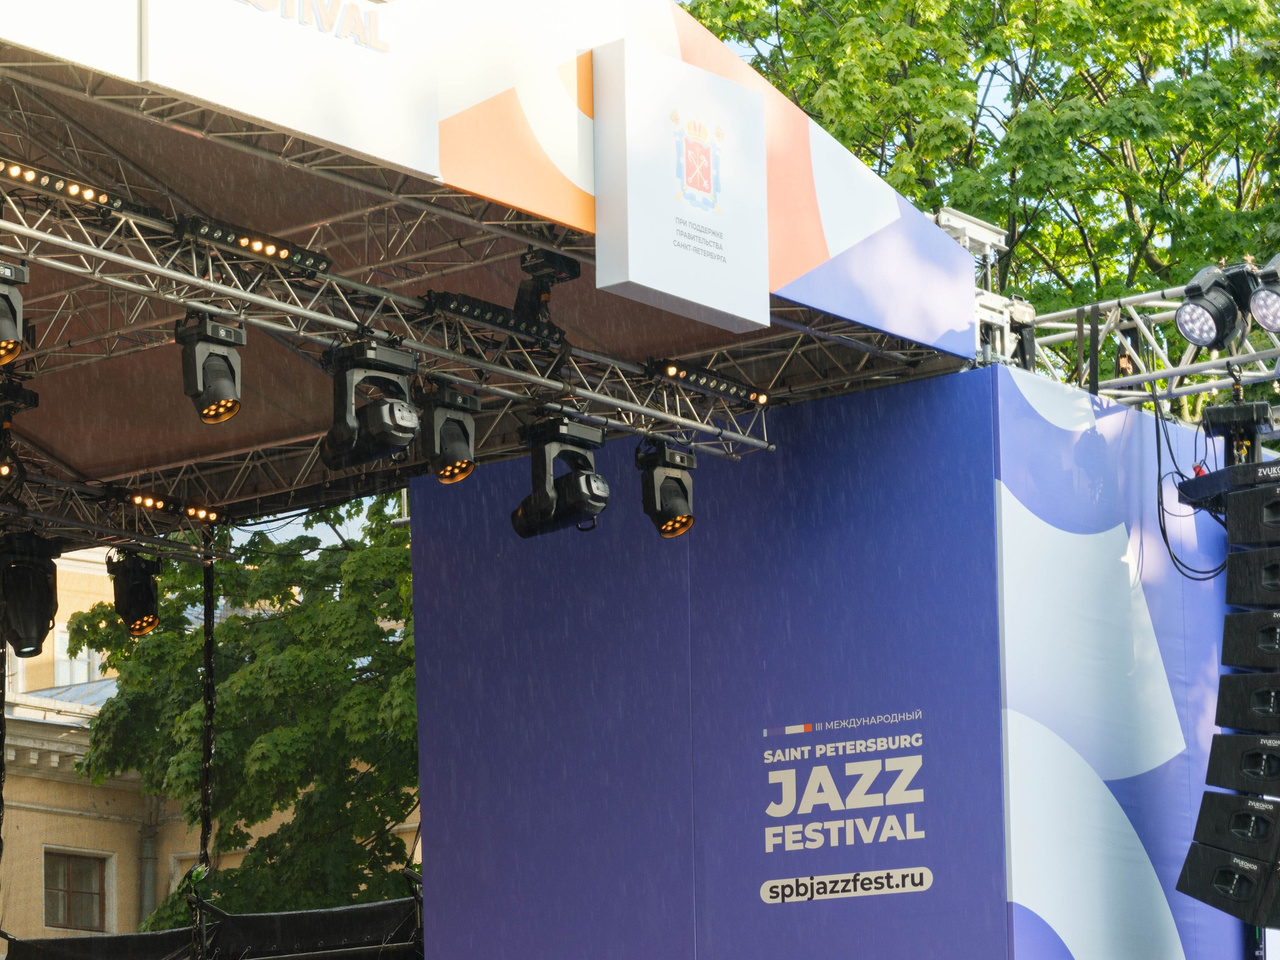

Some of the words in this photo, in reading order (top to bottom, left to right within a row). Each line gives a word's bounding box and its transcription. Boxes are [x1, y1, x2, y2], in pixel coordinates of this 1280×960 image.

[825, 709, 923, 730] МЕЖДУНАРОДНЫЙ
[763, 746, 812, 764] SAINT
[815, 733, 923, 757] PETERSBURG
[765, 755, 925, 818] JAZZ
[765, 813, 926, 853] FESTIVAL
[769, 872, 924, 903] spbjazzfest.ru
